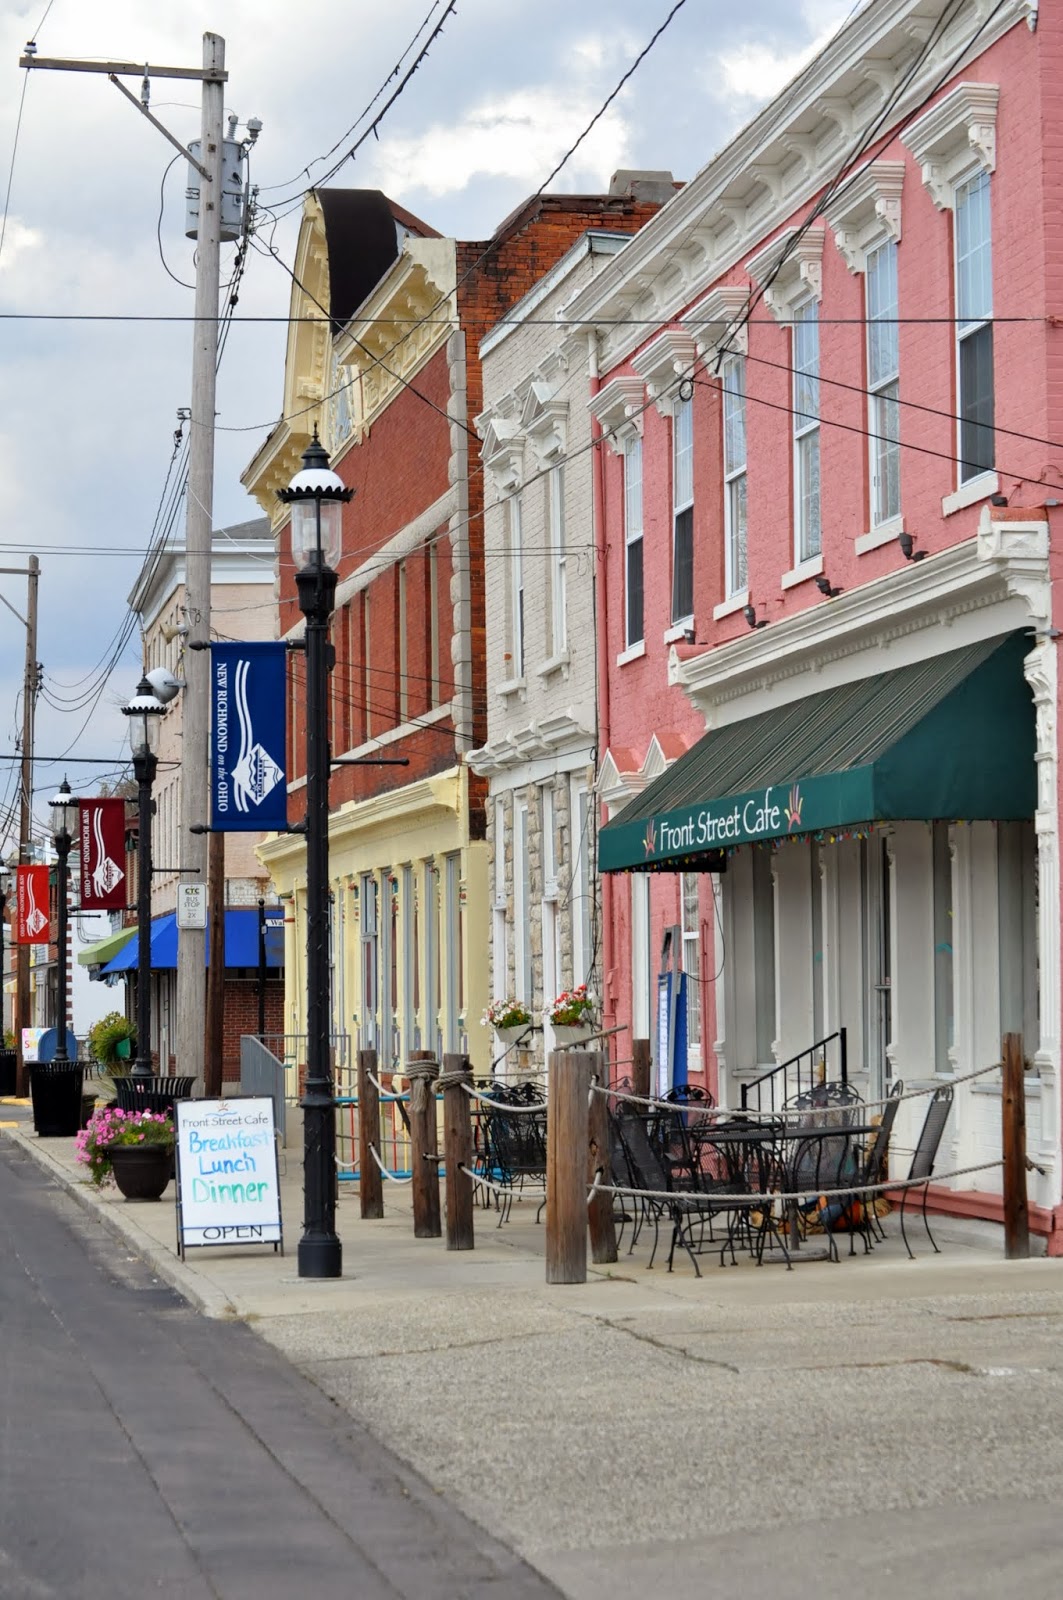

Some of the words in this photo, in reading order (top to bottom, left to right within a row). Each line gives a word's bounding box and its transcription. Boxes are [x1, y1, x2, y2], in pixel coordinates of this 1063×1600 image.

[217, 663, 227, 688] NEW
[217, 690, 228, 753] RICHMOND
[217, 755, 225, 765] on
[217, 767, 227, 780] the
[217, 781, 228, 812] OHIO
[660, 816, 695, 851] Front
[696, 806, 741, 844] Street
[743, 787, 781, 834] Cafe
[182, 1118, 209, 1128] Front
[211, 1116, 243, 1127] Street
[244, 1112, 269, 1125] Cafe
[189, 1129, 269, 1153] Breakfast
[199, 1152, 256, 1175] Lunch
[192, 1178, 268, 1203] Dinner
[203, 1225, 262, 1239] OPEN
